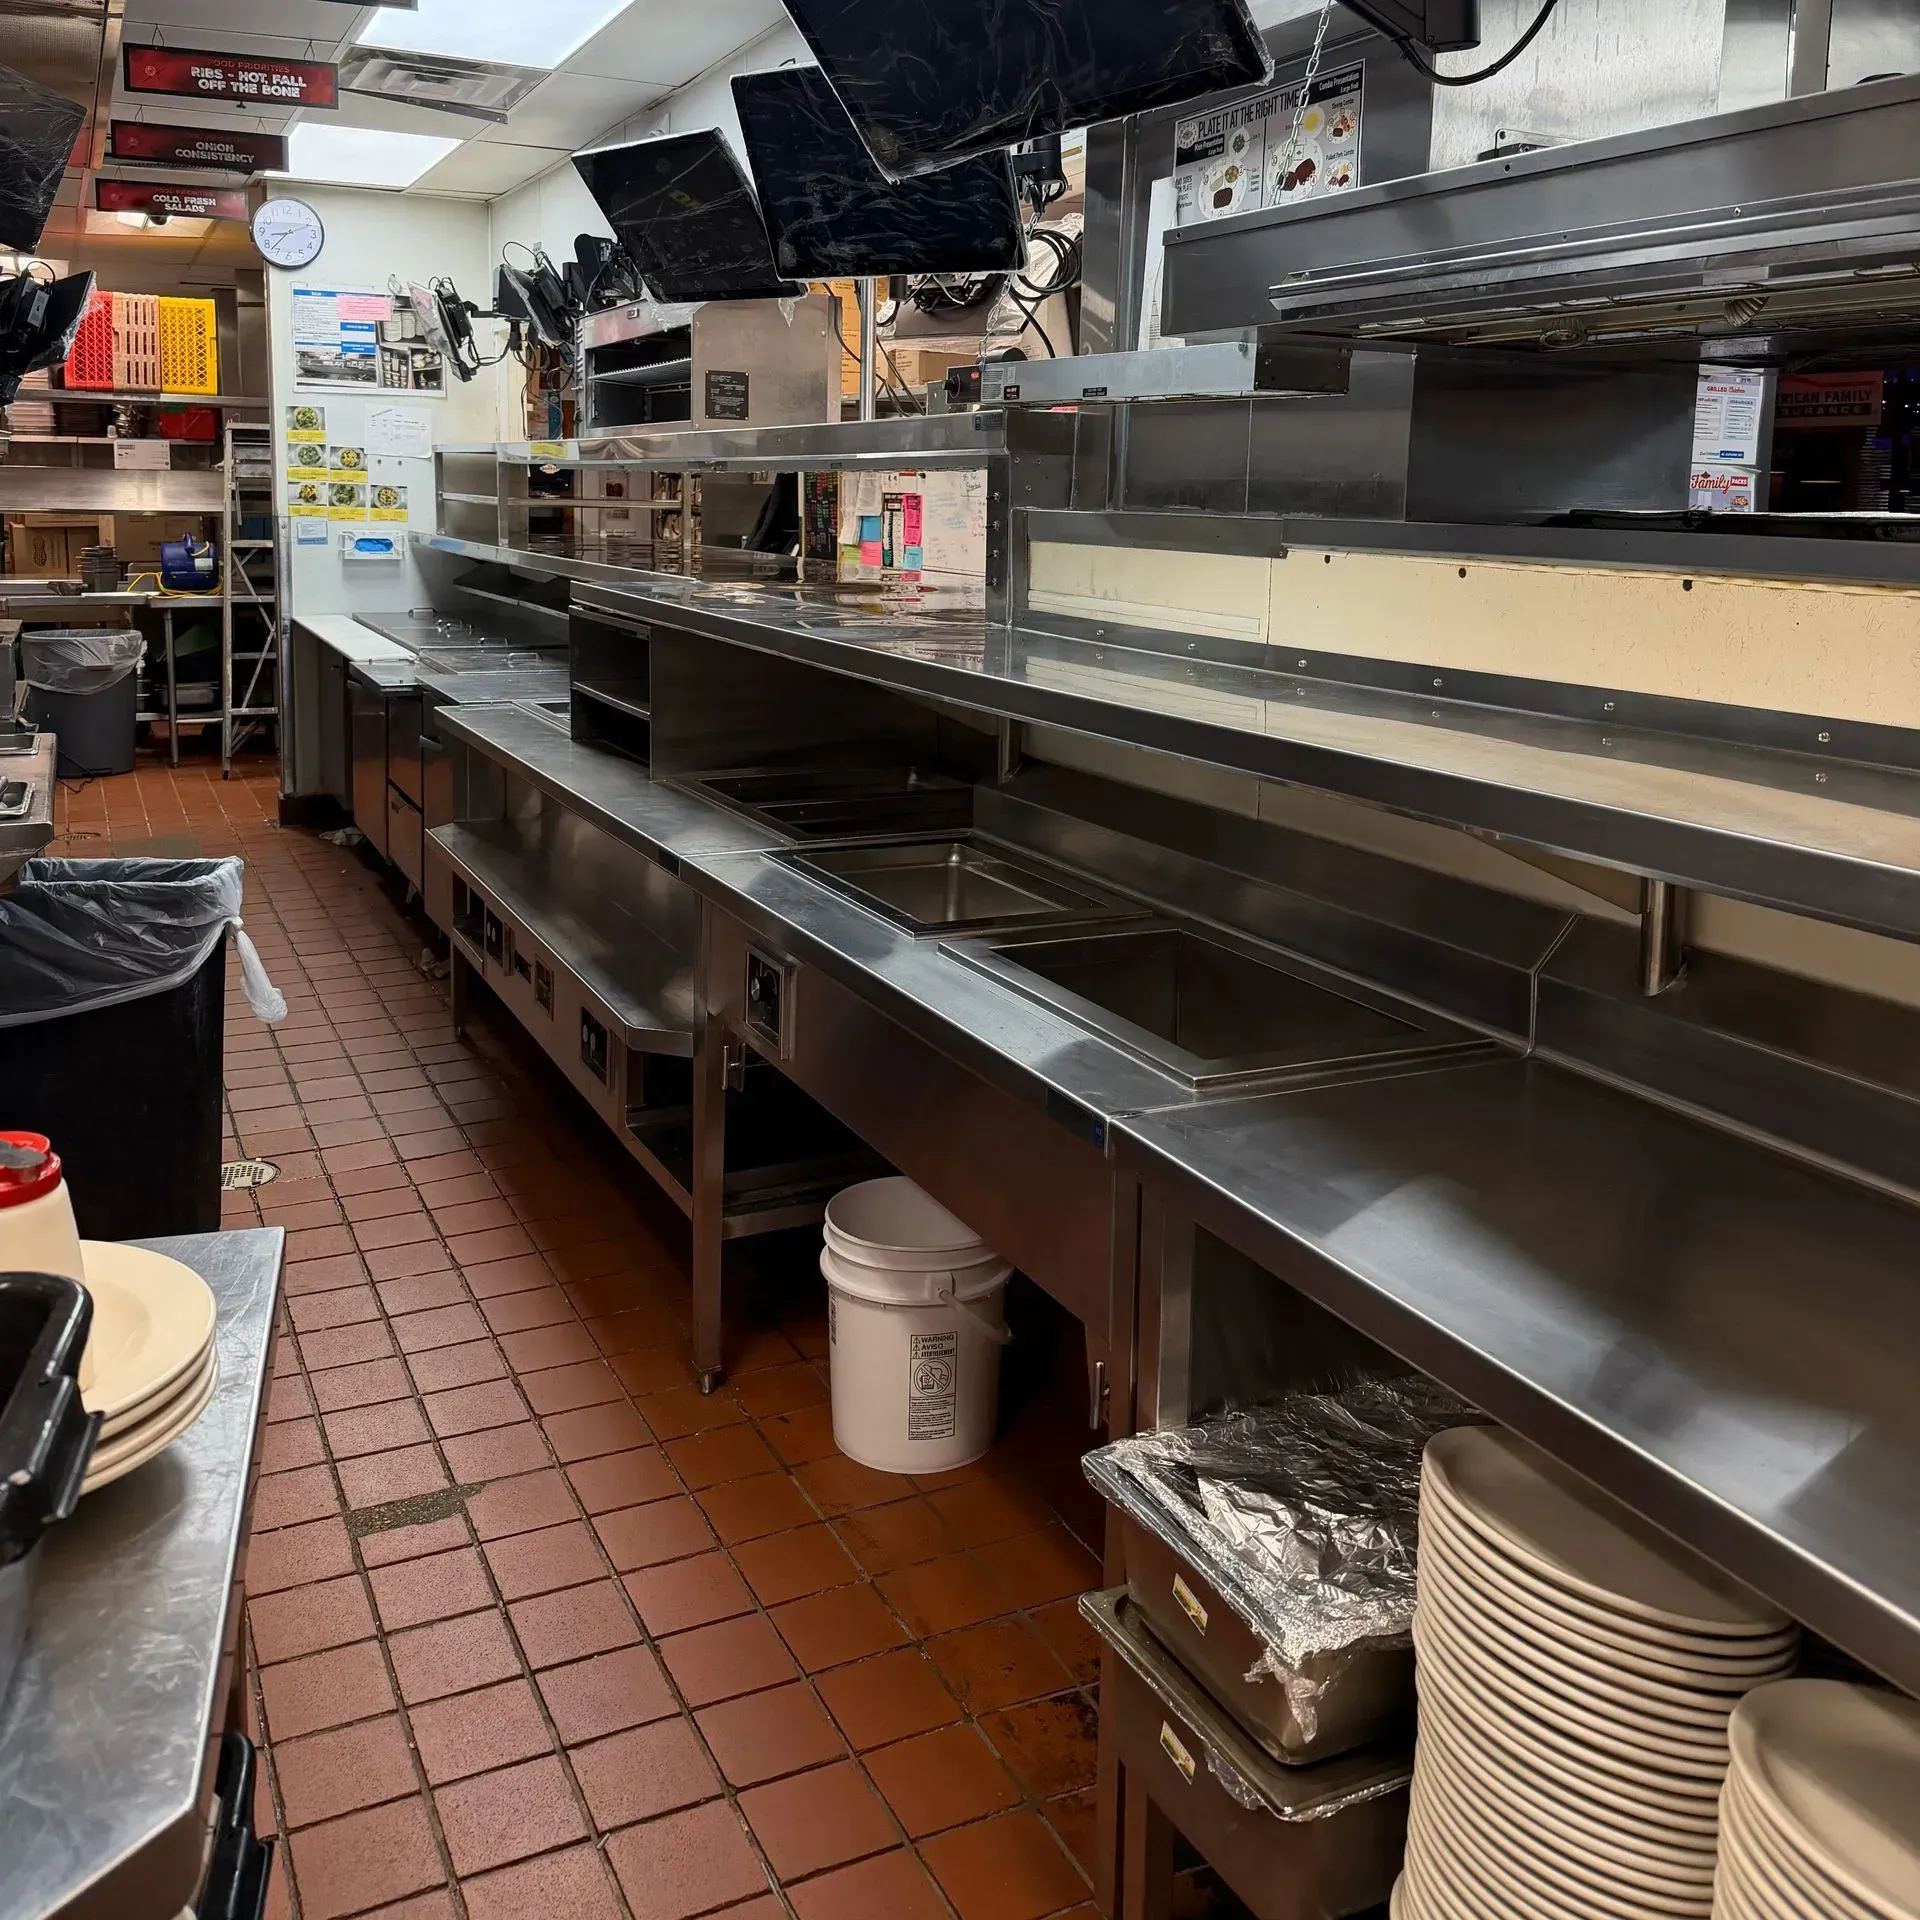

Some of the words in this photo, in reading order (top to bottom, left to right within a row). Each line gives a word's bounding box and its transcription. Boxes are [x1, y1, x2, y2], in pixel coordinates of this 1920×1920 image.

[238, 61, 290, 73] PRIORITIES
[190, 66, 224, 79] RIBS
[272, 74, 308, 88] FALL
[198, 79, 227, 91] OFF
[230, 81, 259, 94] THE
[262, 84, 301, 98] BONE
[1198, 113, 1222, 139] PLATE
[1222, 112, 1229, 132] IT
[1229, 109, 1240, 129] AT
[1239, 105, 1254, 127] THE
[1255, 98, 1279, 121] RIGHT
[195, 141, 235, 153] ONION
[175, 149, 255, 163] CONSISTENCY
[184, 196, 217, 206] FRESH
[165, 203, 206, 213] SALADS
[283, 205, 292, 214] 12
[258, 227, 265, 236] 9
[310, 229, 317, 239] 3
[264, 239, 271, 249] 8
[307, 242, 313, 250] 4
[275, 247, 280, 256] 7
[286, 251, 292, 260] 6
[298, 249, 304, 258] 5
[1825, 388, 1873, 403] FAMILY
[1780, 405, 1862, 416] SURANCE
[1691, 473, 1731, 494] Family
[921, 1334, 954, 1342] WARNING
